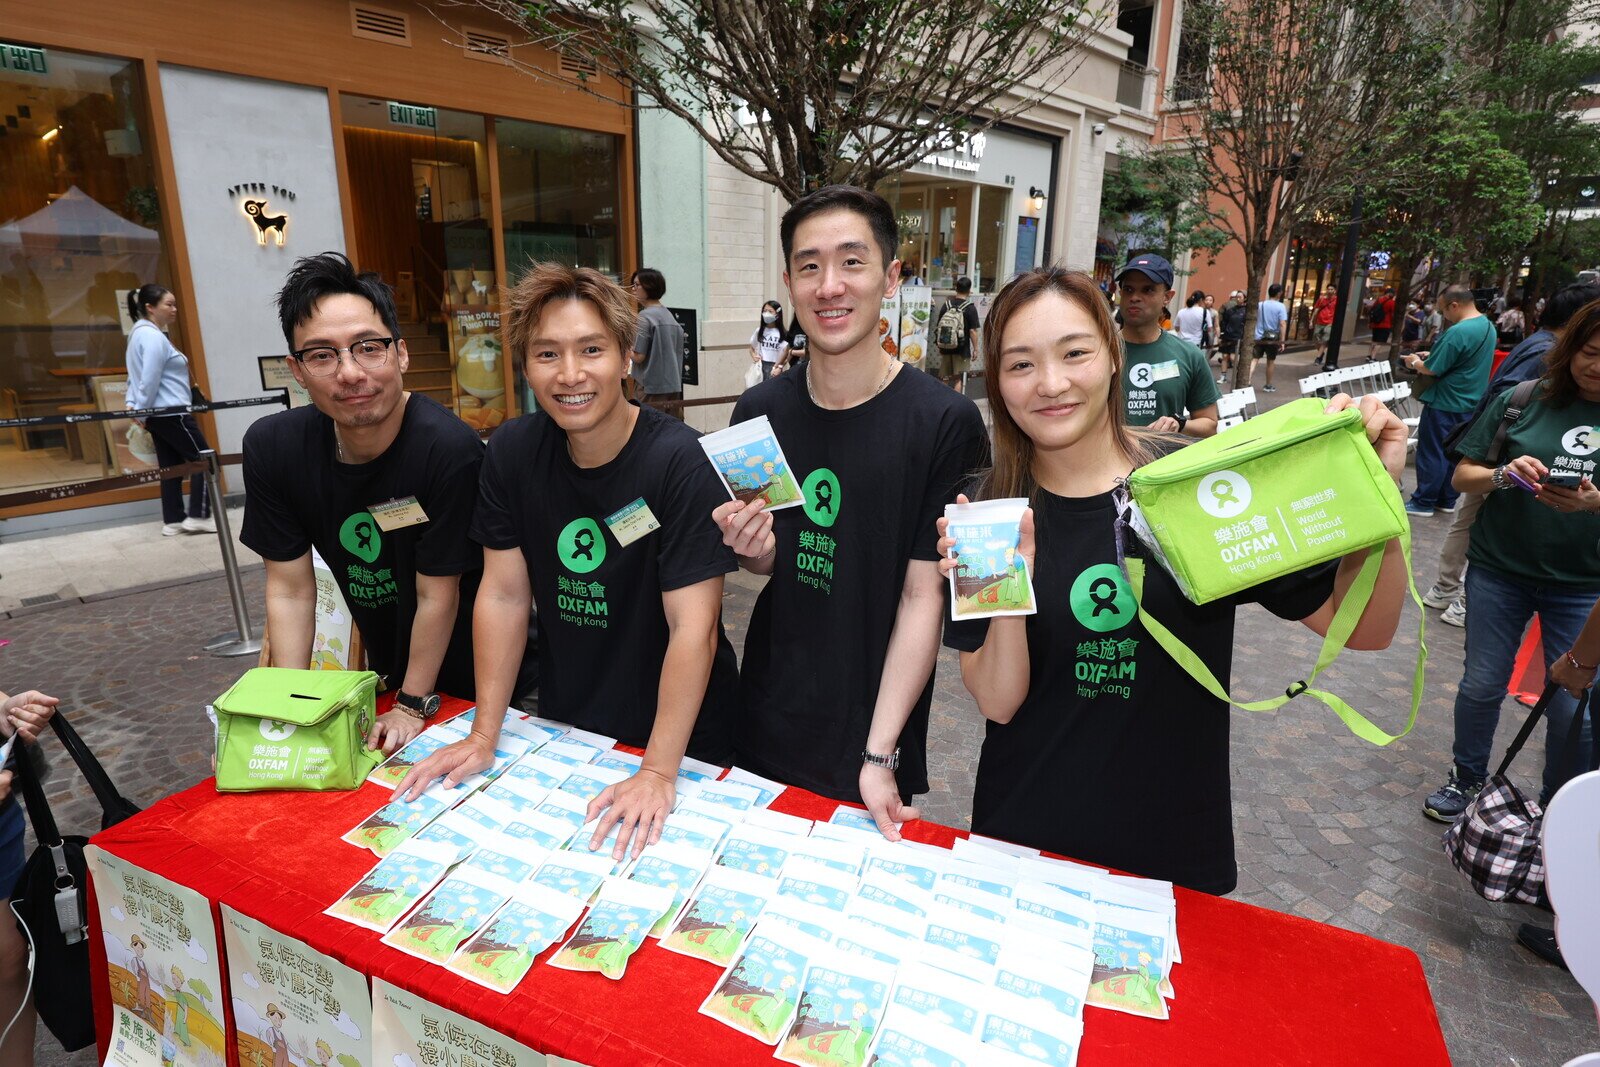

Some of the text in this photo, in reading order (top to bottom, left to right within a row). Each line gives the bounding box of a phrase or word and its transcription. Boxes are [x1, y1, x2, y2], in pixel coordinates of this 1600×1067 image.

[389, 104, 436, 128] EXIT 出口
[227, 182, 297, 202] AFTER YOU
[761, 341, 781, 350] TIME
[1127, 400, 1157, 409] OXFAM
[1296, 509, 1328, 526] World
[1301, 516, 1343, 537] Without
[1213, 514, 1269, 546] 樂施會
[1306, 527, 1347, 548] Poverty
[799, 529, 837, 559] 樂施會
[1219, 531, 1279, 564] OXFAM
[796, 552, 834, 580] OXFAM
[1229, 549, 1283, 575] Hong Kong
[346, 564, 392, 585] 樂施會
[797, 572, 832, 596] Hong Kong
[349, 580, 399, 600] OXFAM
[557, 575, 606, 599] 樂施會
[355, 595, 399, 609] Hong Kong
[557, 594, 609, 616] OXFAM
[560, 611, 608, 628] Hong Kong
[1075, 637, 1140, 660] 樂施會
[1075, 661, 1137, 684] OXFAM
[1076, 682, 1131, 700] Hong Kong
[251, 744, 292, 758] 樂施會
[305, 757, 325, 765] World
[248, 758, 289, 771] OXFAM
[303, 764, 329, 773] Without
[248, 771, 284, 780] Hong Kong
[302, 773, 326, 781] Poverty
[122, 871, 185, 921] 氣候在變
[122, 894, 191, 947] 撐小農不變
[258, 936, 334, 992] 氣候在變
[257, 960, 341, 1021] 撐小農不變
[120, 1011, 157, 1048] 樂施米
[421, 1013, 517, 1067] 氣候在變
